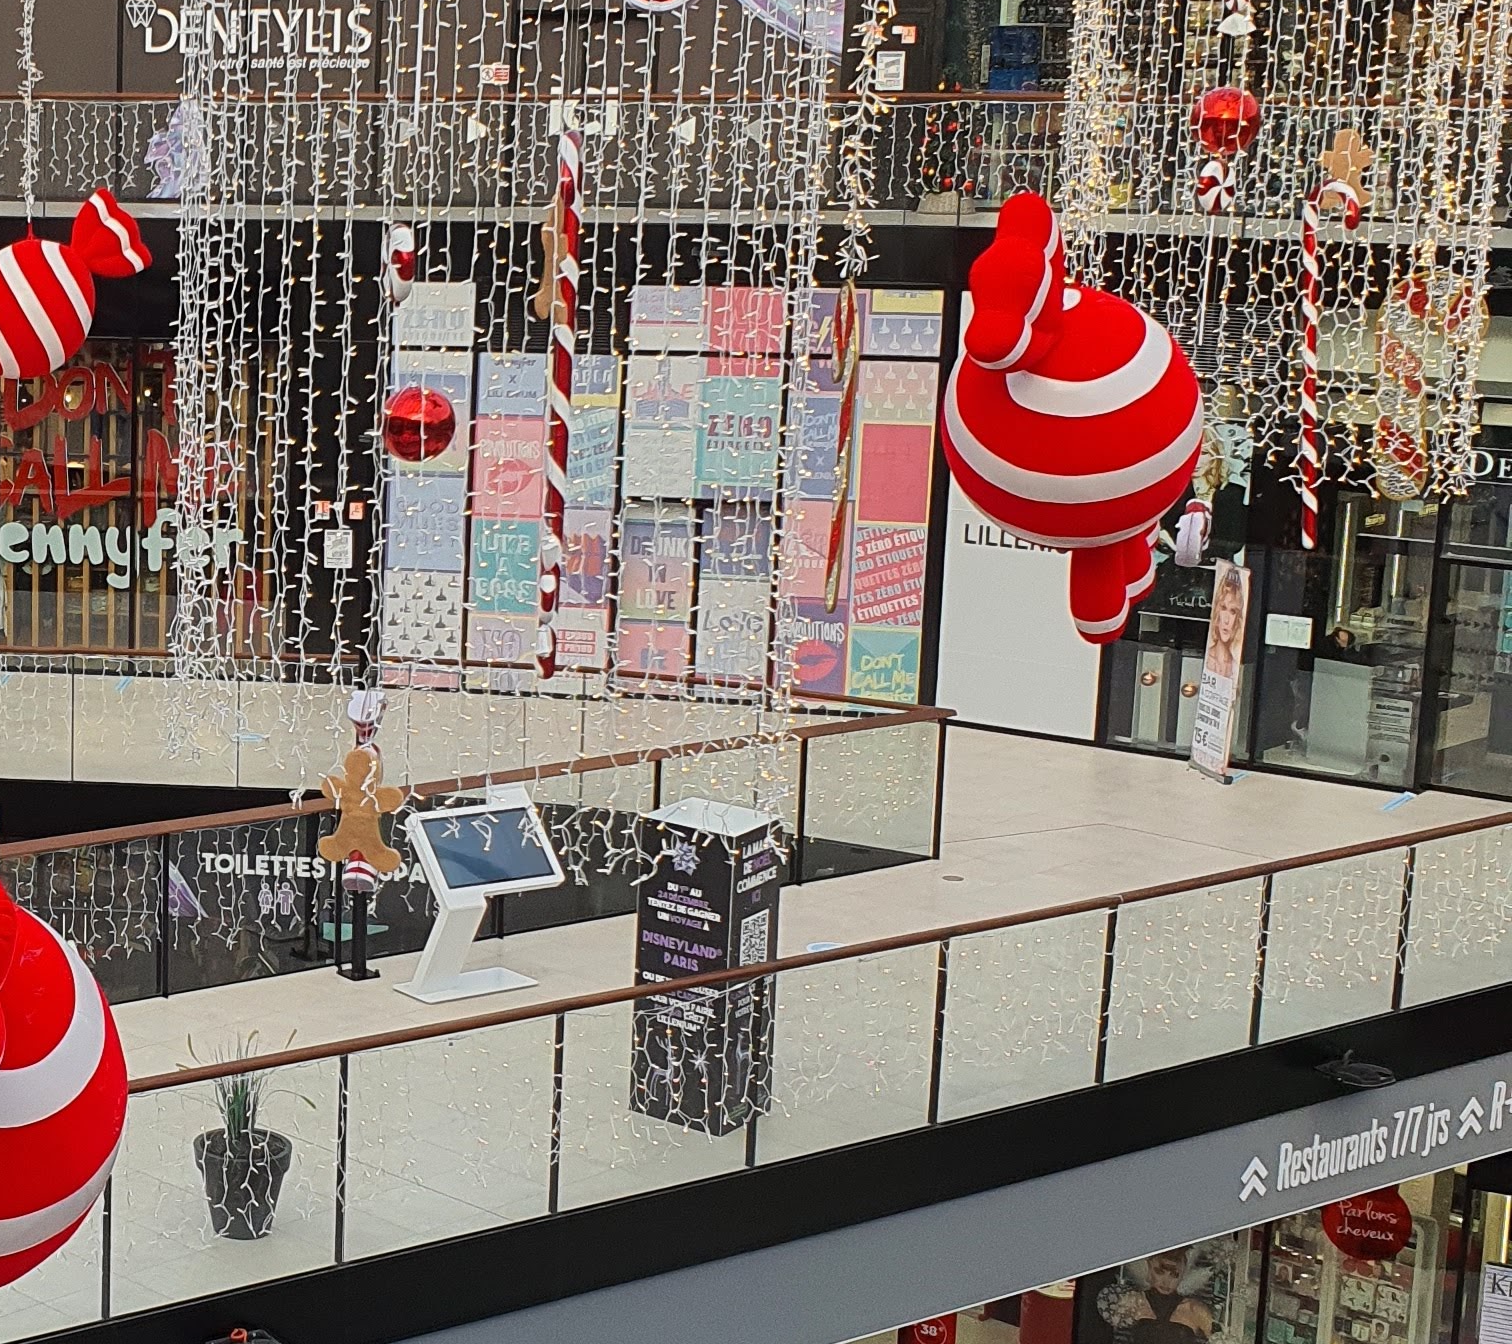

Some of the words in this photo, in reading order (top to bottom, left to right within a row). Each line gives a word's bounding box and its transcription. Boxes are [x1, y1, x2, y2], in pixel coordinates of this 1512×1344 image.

[145, 8, 372, 54] DENTYLIS
[964, 523, 1070, 554] LILLE
[857, 594, 919, 623] ÉTIQUETTES
[201, 852, 326, 879] TOILETTES
[688, 906, 722, 923] GAGNER
[663, 951, 699, 972] PARIS
[1276, 1118, 1389, 1192] Restaurants
[1391, 1104, 1425, 1159] 7/7
[1421, 1102, 1451, 1158] jrs
[1338, 1198, 1399, 1225] Parlons
[1336, 1220, 1396, 1242] cheveux
